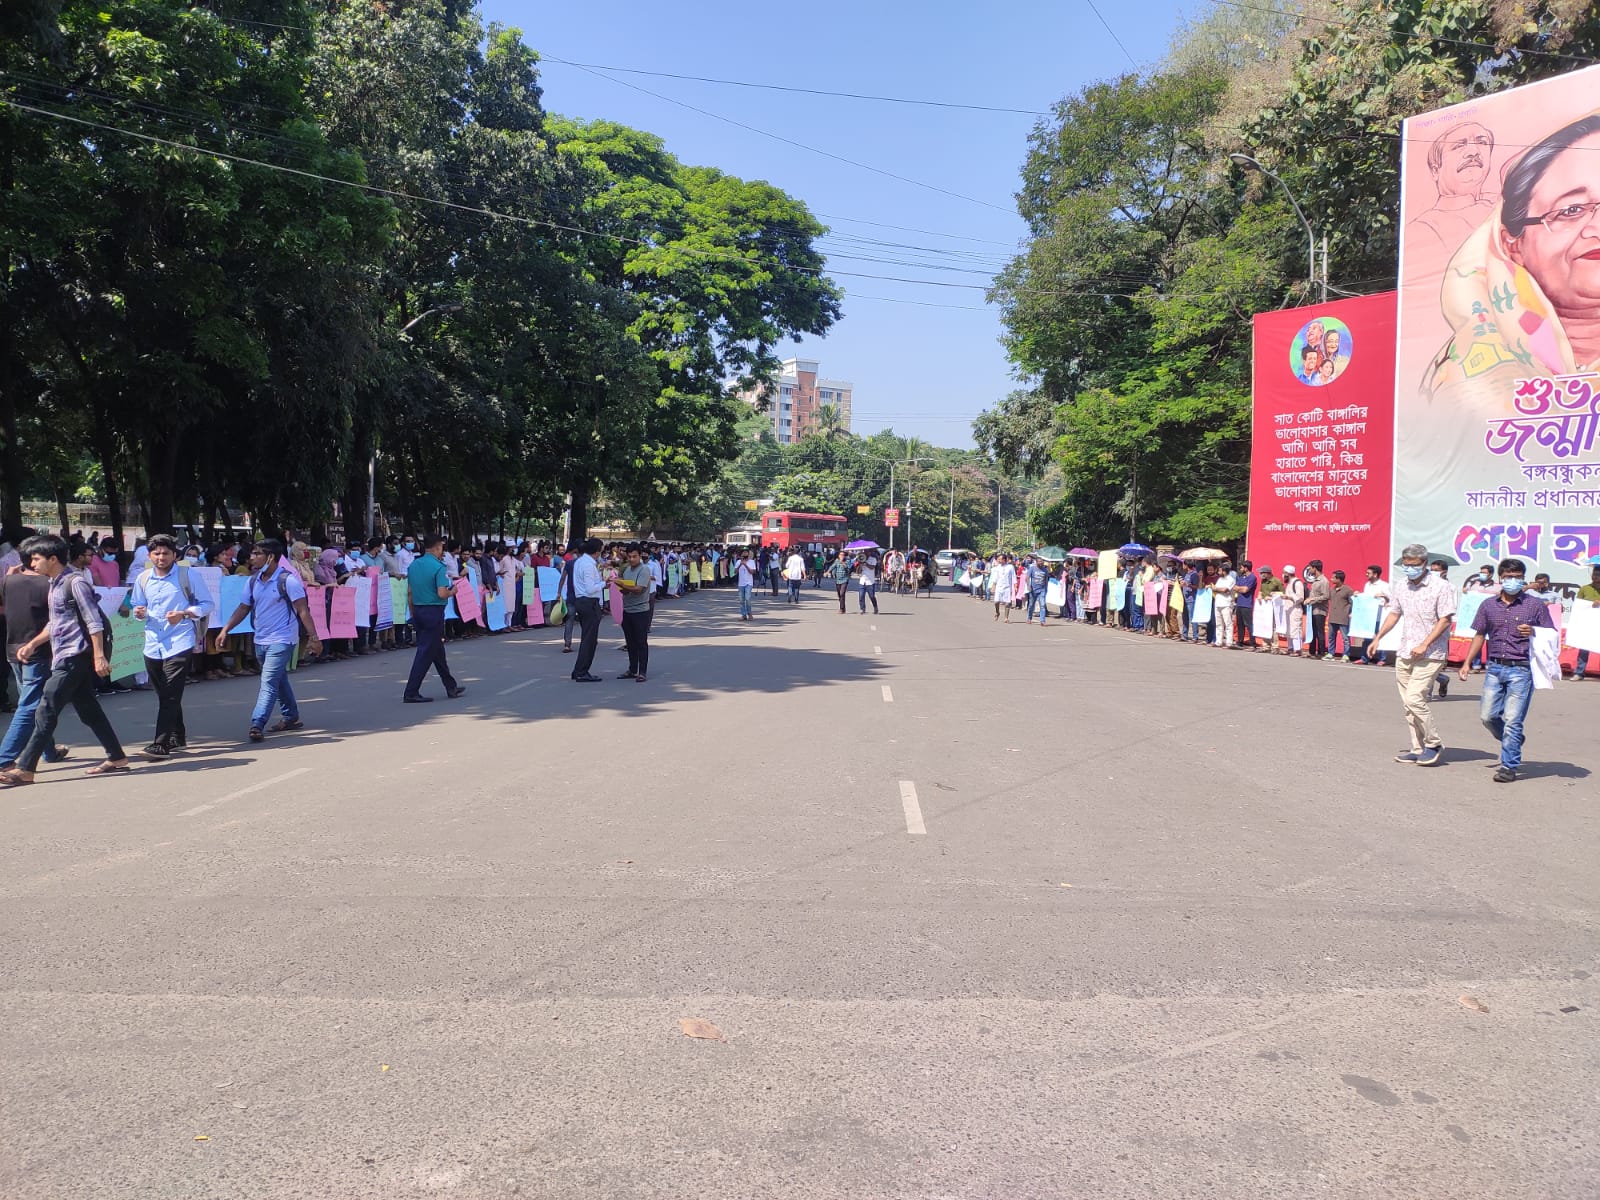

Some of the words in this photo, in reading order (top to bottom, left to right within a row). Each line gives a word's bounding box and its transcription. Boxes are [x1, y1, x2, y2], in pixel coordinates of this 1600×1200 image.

[1514, 373, 1598, 415] শুভ
[1274, 413, 1294, 425] সাত
[1297, 407, 1324, 423] কোটি
[1327, 404, 1368, 420] বাঙ্গালির
[1275, 425, 1328, 439] ভালোবাসার
[1332, 422, 1366, 435] কাঙ্গাল
[1281, 439, 1308, 454] আমি।
[1312, 437, 1336, 451] আমি
[1340, 438, 1358, 450] সব
[1275, 457, 1307, 469] হারাতে
[1311, 452, 1336, 468] পারি,
[1340, 451, 1363, 466] কিন্তু
[1271, 470, 1324, 483] বাংলাদেশের
[1328, 469, 1368, 484] মানুষের
[1521, 463, 1600, 485] বঙ্গবন্ধুক
[1275, 485, 1322, 498] ভালোবাসা
[1326, 484, 1362, 497] হারাতে
[1466, 486, 1527, 508] মাননীয়
[1533, 489, 1600, 508] প্রধানম
[1294, 500, 1319, 512] পারব
[1322, 500, 1338, 511] না।
[1455, 525, 1541, 562] শেখ
[1553, 525, 1600, 566] হা
